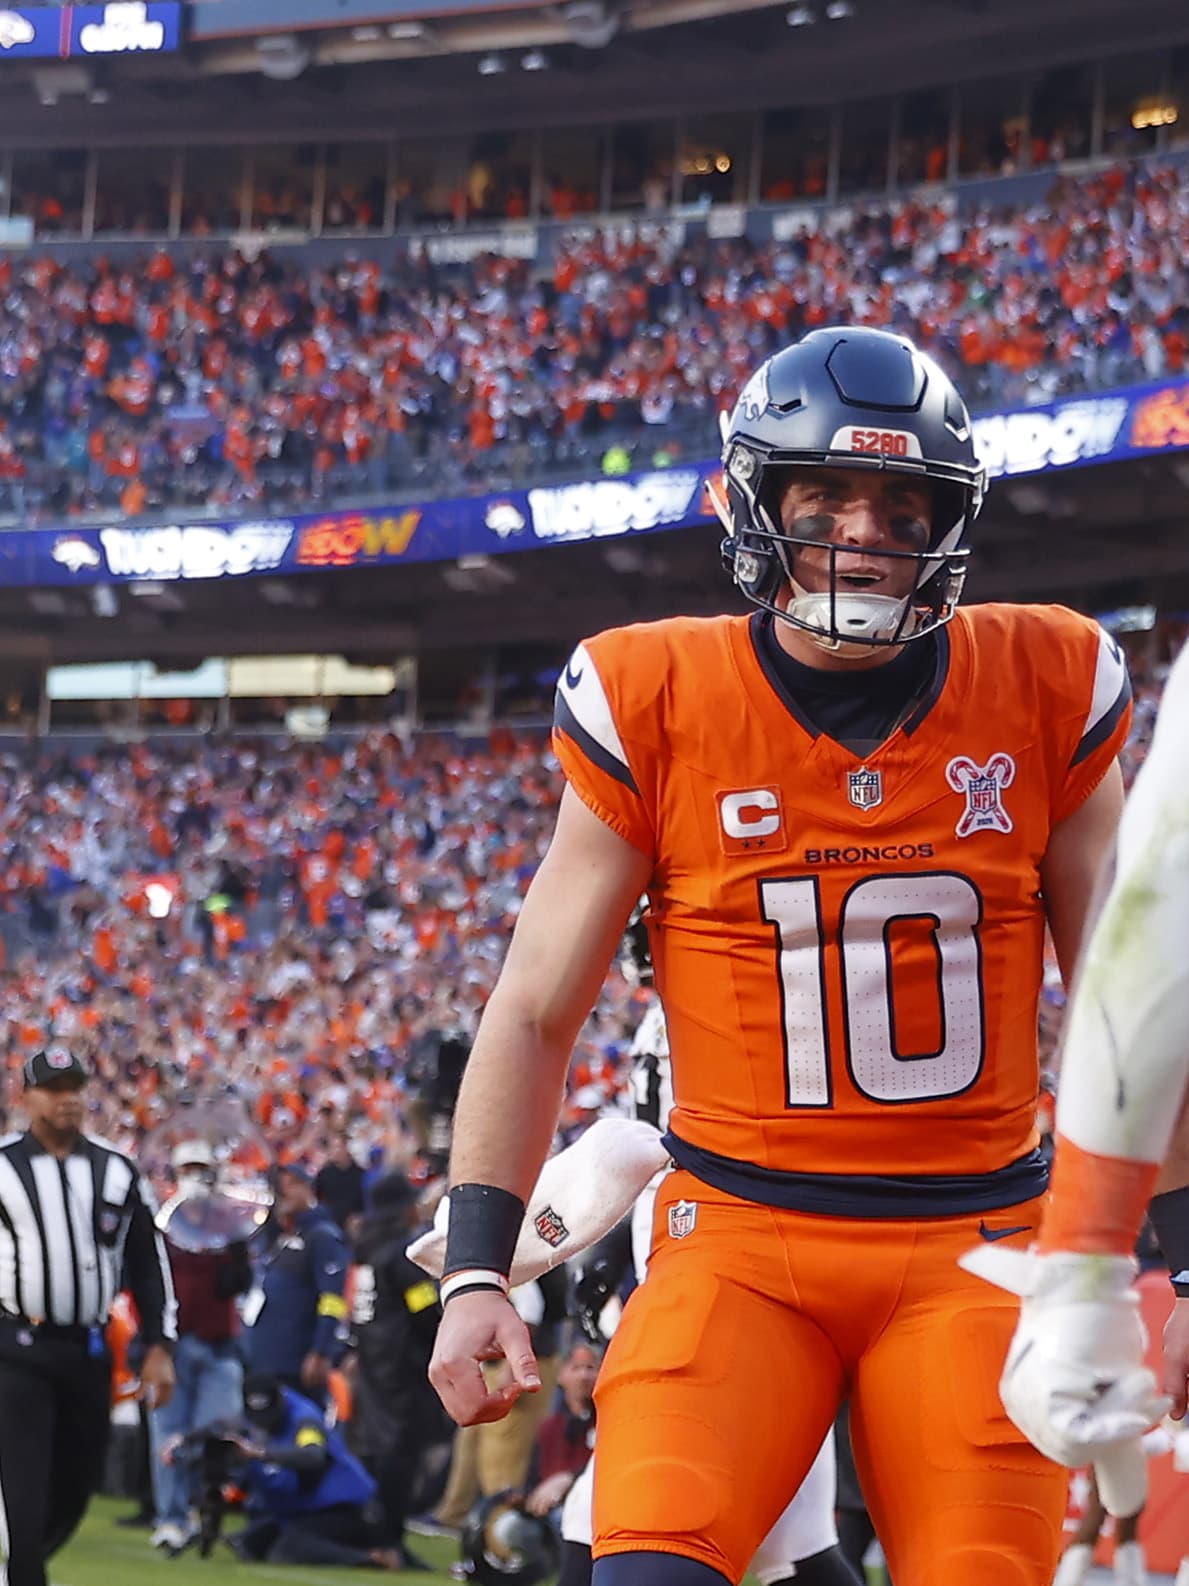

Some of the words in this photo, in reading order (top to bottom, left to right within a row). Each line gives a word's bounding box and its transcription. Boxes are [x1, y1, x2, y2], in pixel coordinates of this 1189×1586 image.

[851, 430, 907, 457] 5280
[852, 785, 878, 804] NFL
[972, 790, 996, 810] NFL
[720, 790, 780, 839] C
[806, 843, 935, 864] BRONCOS
[757, 870, 985, 1109] 10
